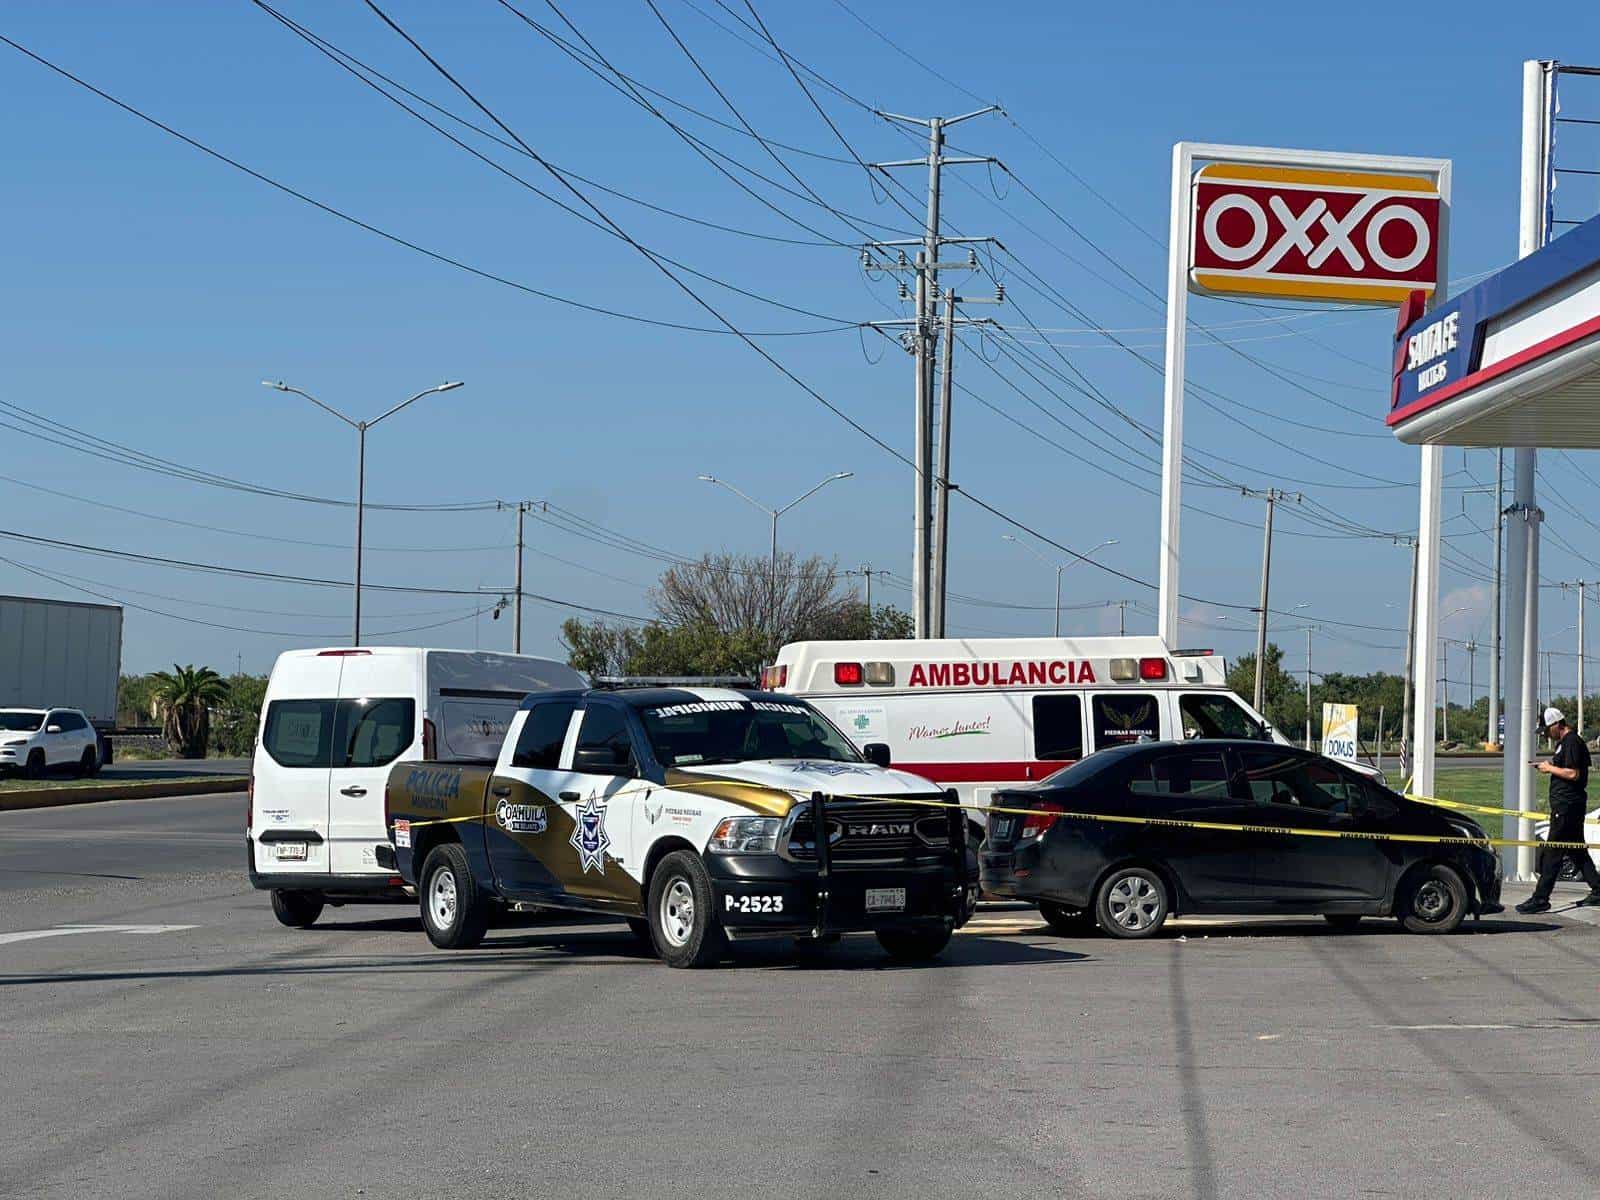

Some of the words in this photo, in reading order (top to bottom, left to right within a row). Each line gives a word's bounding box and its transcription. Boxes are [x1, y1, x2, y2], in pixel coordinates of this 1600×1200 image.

[1203, 193, 1431, 273] OXXO
[908, 660, 1096, 687] AMBULANCIA
[1328, 739, 1354, 757] DOMUS
[848, 823, 911, 836] RAM
[724, 894, 784, 913] P-2523
